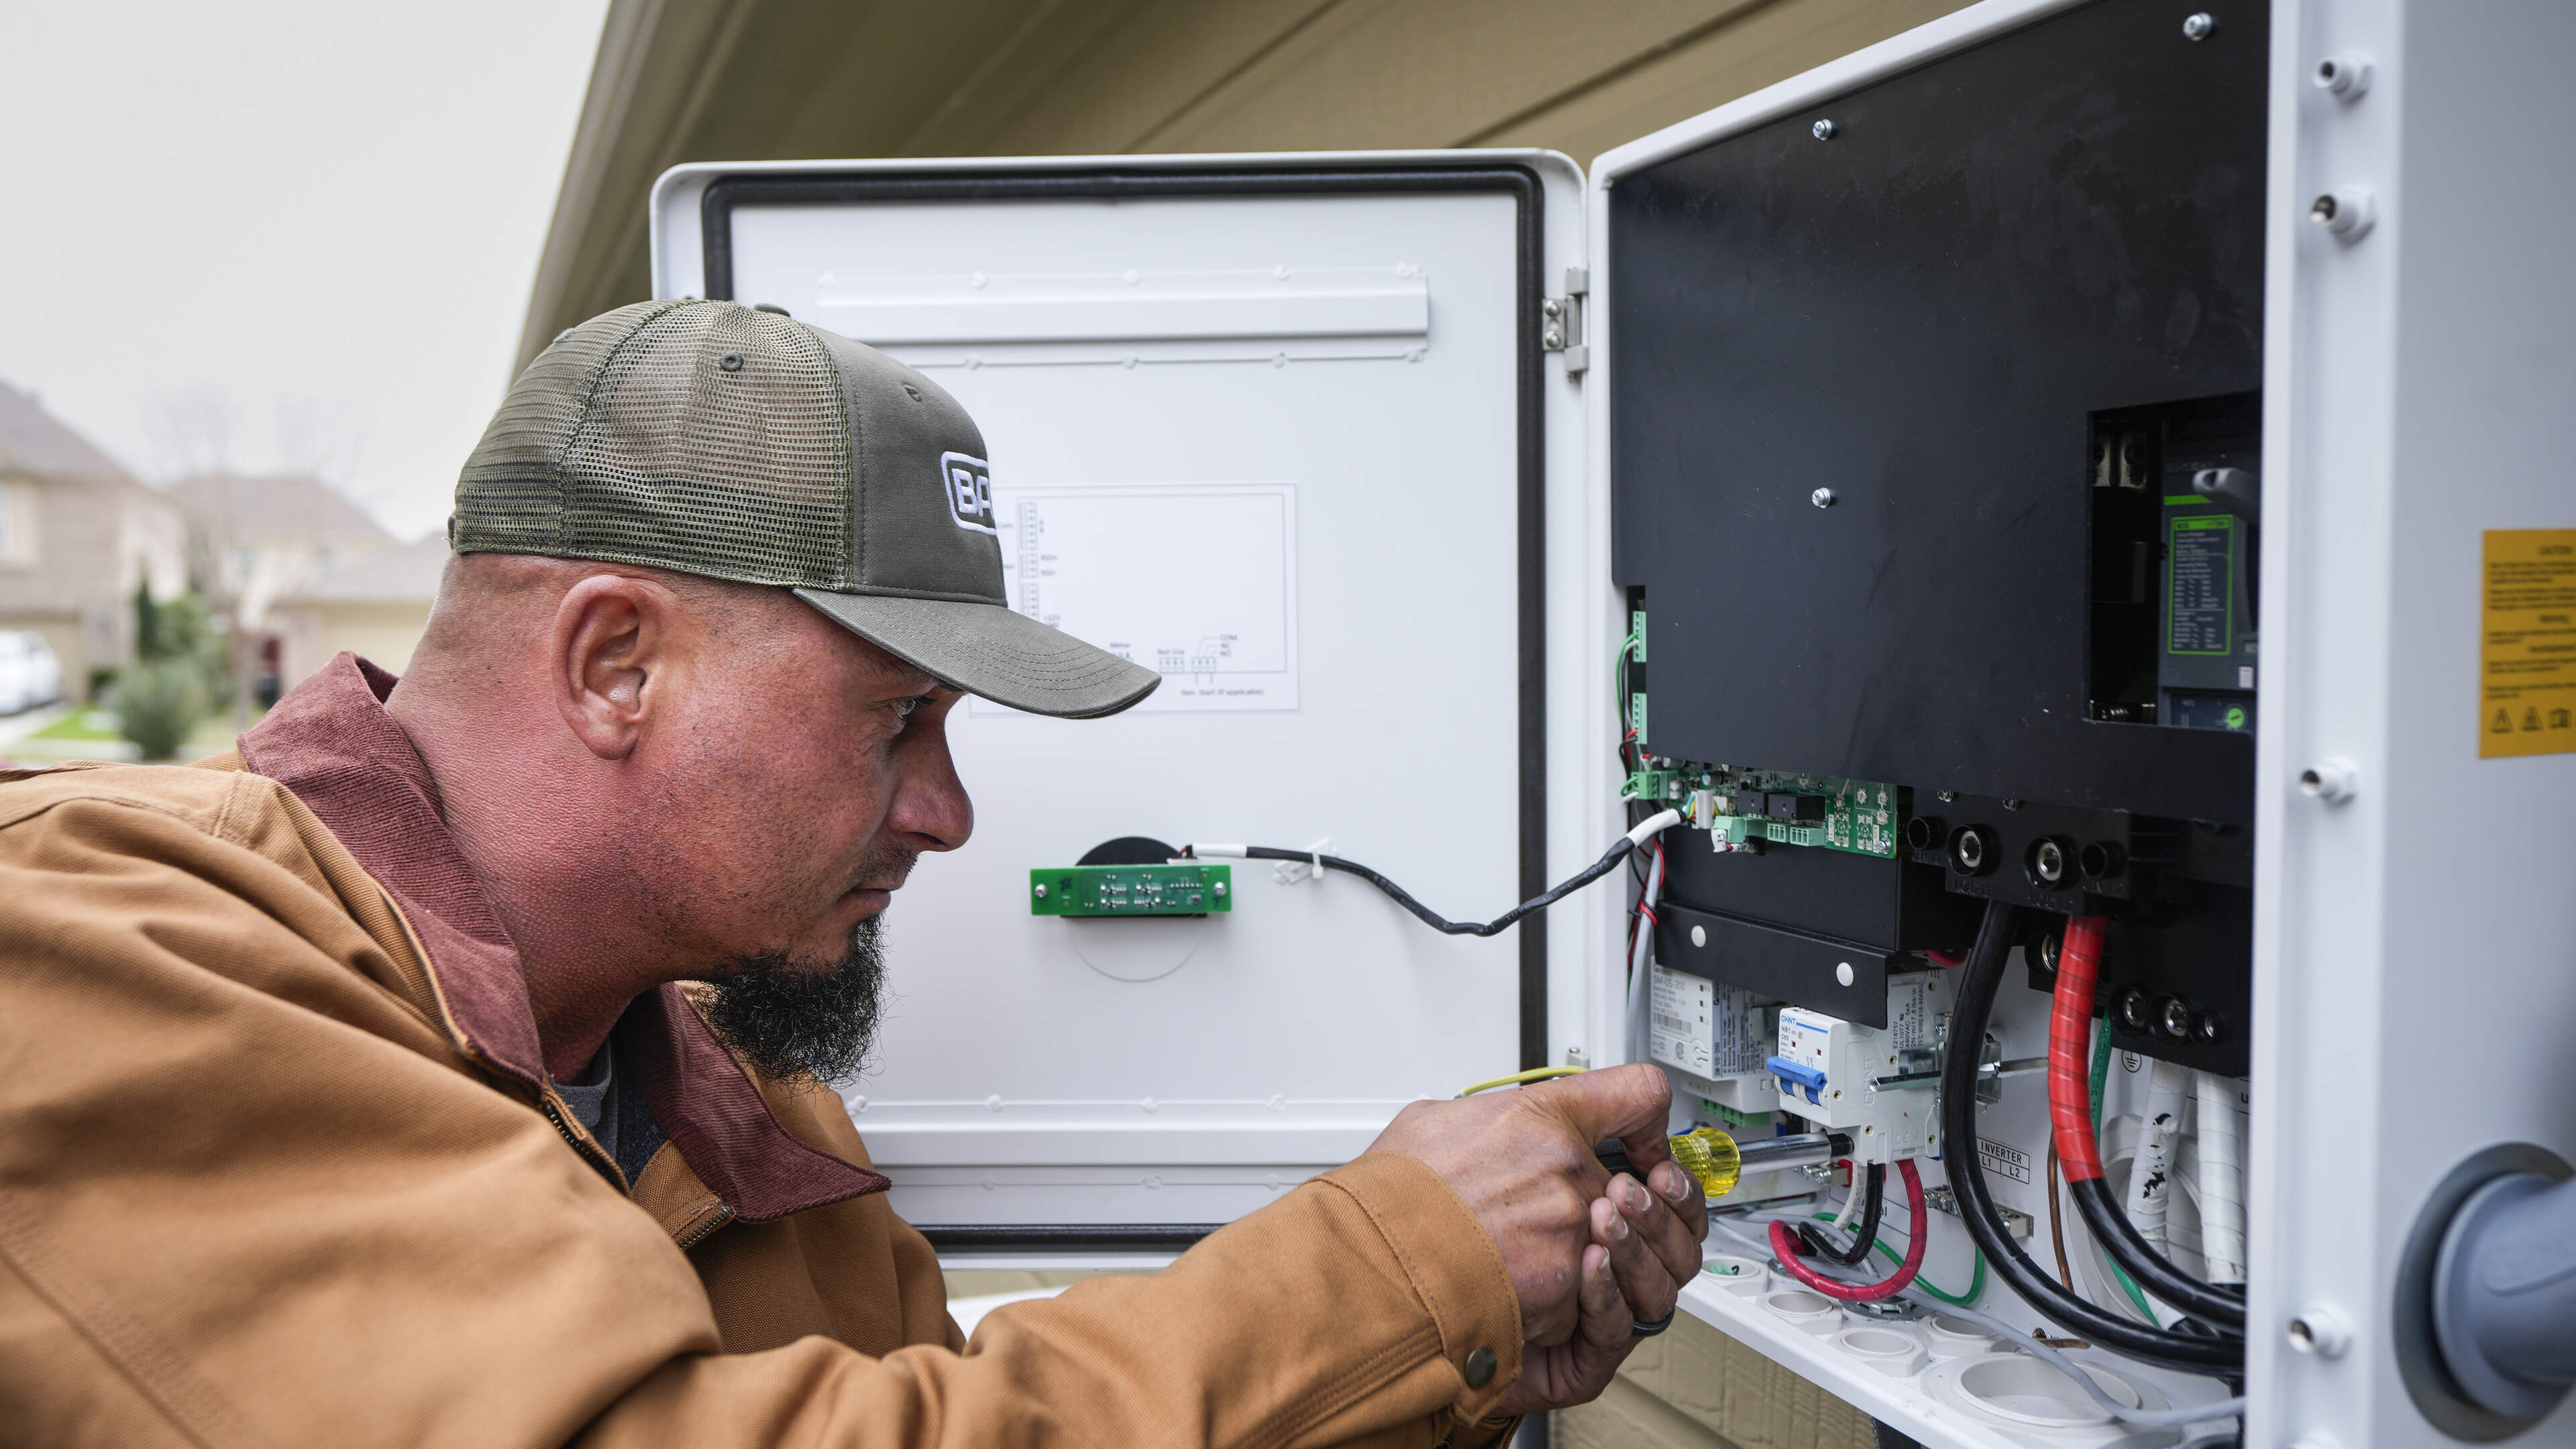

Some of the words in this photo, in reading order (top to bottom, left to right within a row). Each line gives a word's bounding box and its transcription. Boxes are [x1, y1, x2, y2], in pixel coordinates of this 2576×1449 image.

[1781, 1015, 1796, 1025] CHNT
[1981, 1141, 2022, 1165] INVERTER
[1982, 1155, 1991, 1167] L1
[2009, 1165, 2020, 1178] L2
